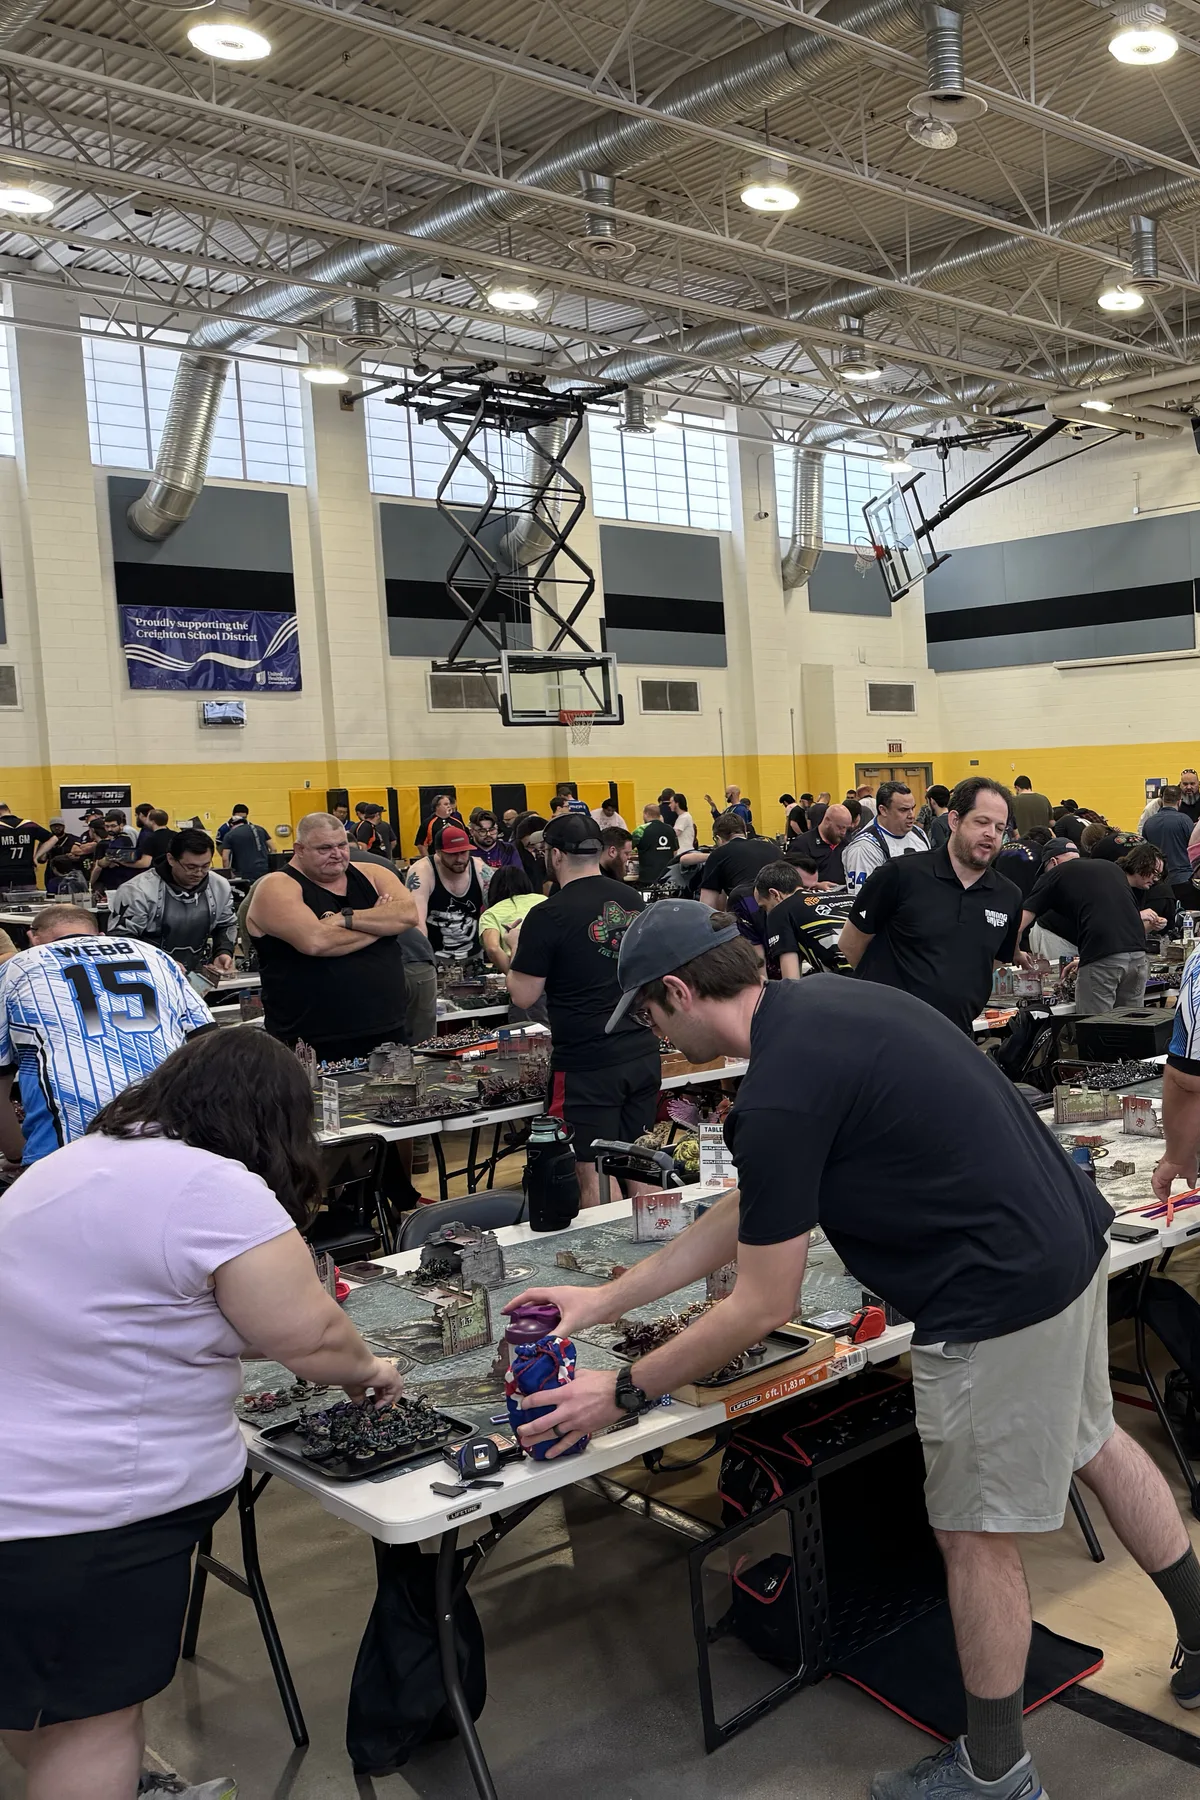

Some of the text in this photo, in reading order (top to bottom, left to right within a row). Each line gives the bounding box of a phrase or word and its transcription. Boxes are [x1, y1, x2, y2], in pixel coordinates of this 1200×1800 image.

[135, 618, 249, 632] Proudly supporting the
[136, 629, 258, 642] Creighton School District
[67, 791, 125, 799] CHAMPIONS
[1, 834, 31, 846] MR. GM
[10, 847, 24, 860] 77
[54, 942, 135, 958] WEBB
[62, 959, 162, 1039] 15
[732, 1395, 759, 1412] LIFETIME
[765, 1390, 771, 1400] 6
[770, 1388, 779, 1397] ft.
[783, 1379, 799, 1394] 1,83
[799, 1377, 806, 1387] m
[451, 1505, 478, 1519] LIFETIME
